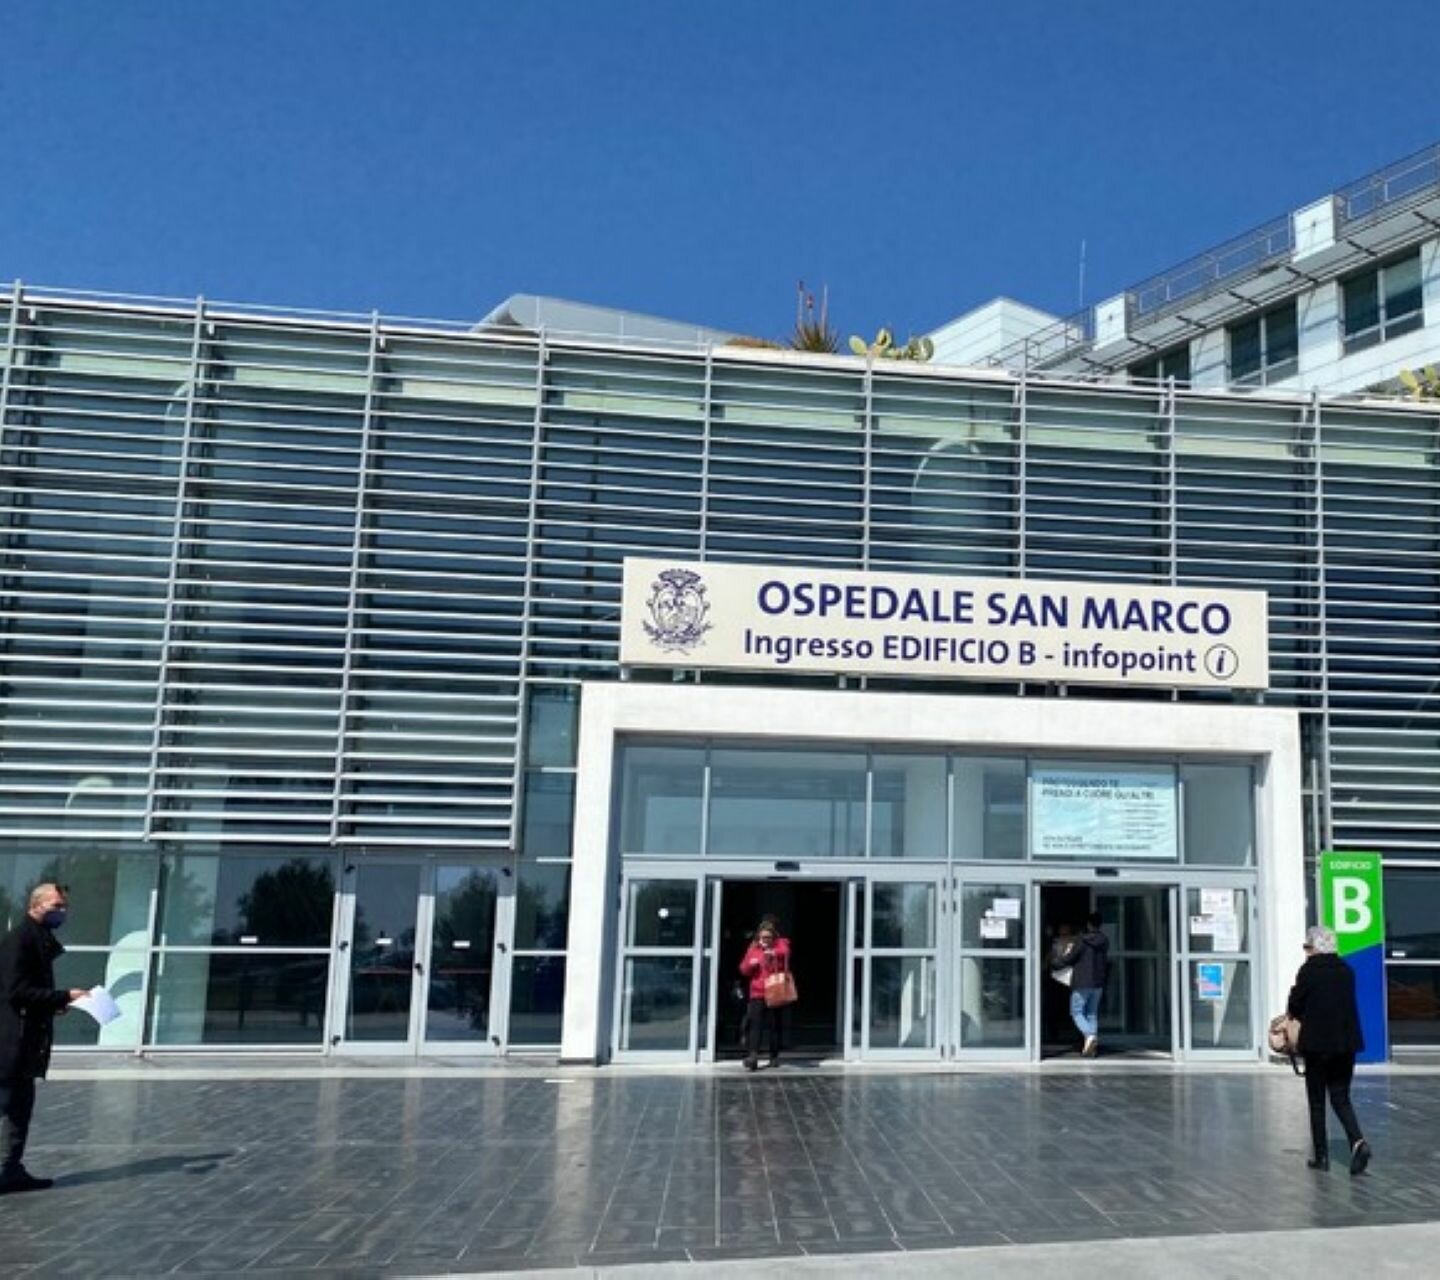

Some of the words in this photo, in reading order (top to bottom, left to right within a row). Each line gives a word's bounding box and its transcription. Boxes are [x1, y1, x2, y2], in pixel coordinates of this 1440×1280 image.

[758, 580, 974, 624] OSPEDALE
[987, 592, 1068, 628] SAN
[1081, 597, 1231, 635] MARCO
[745, 629, 873, 664] Ingresso
[883, 635, 1009, 664] EDIFICIO
[1019, 641, 1036, 666] B
[1064, 642, 1196, 677] infopoint
[1333, 876, 1372, 932] B
